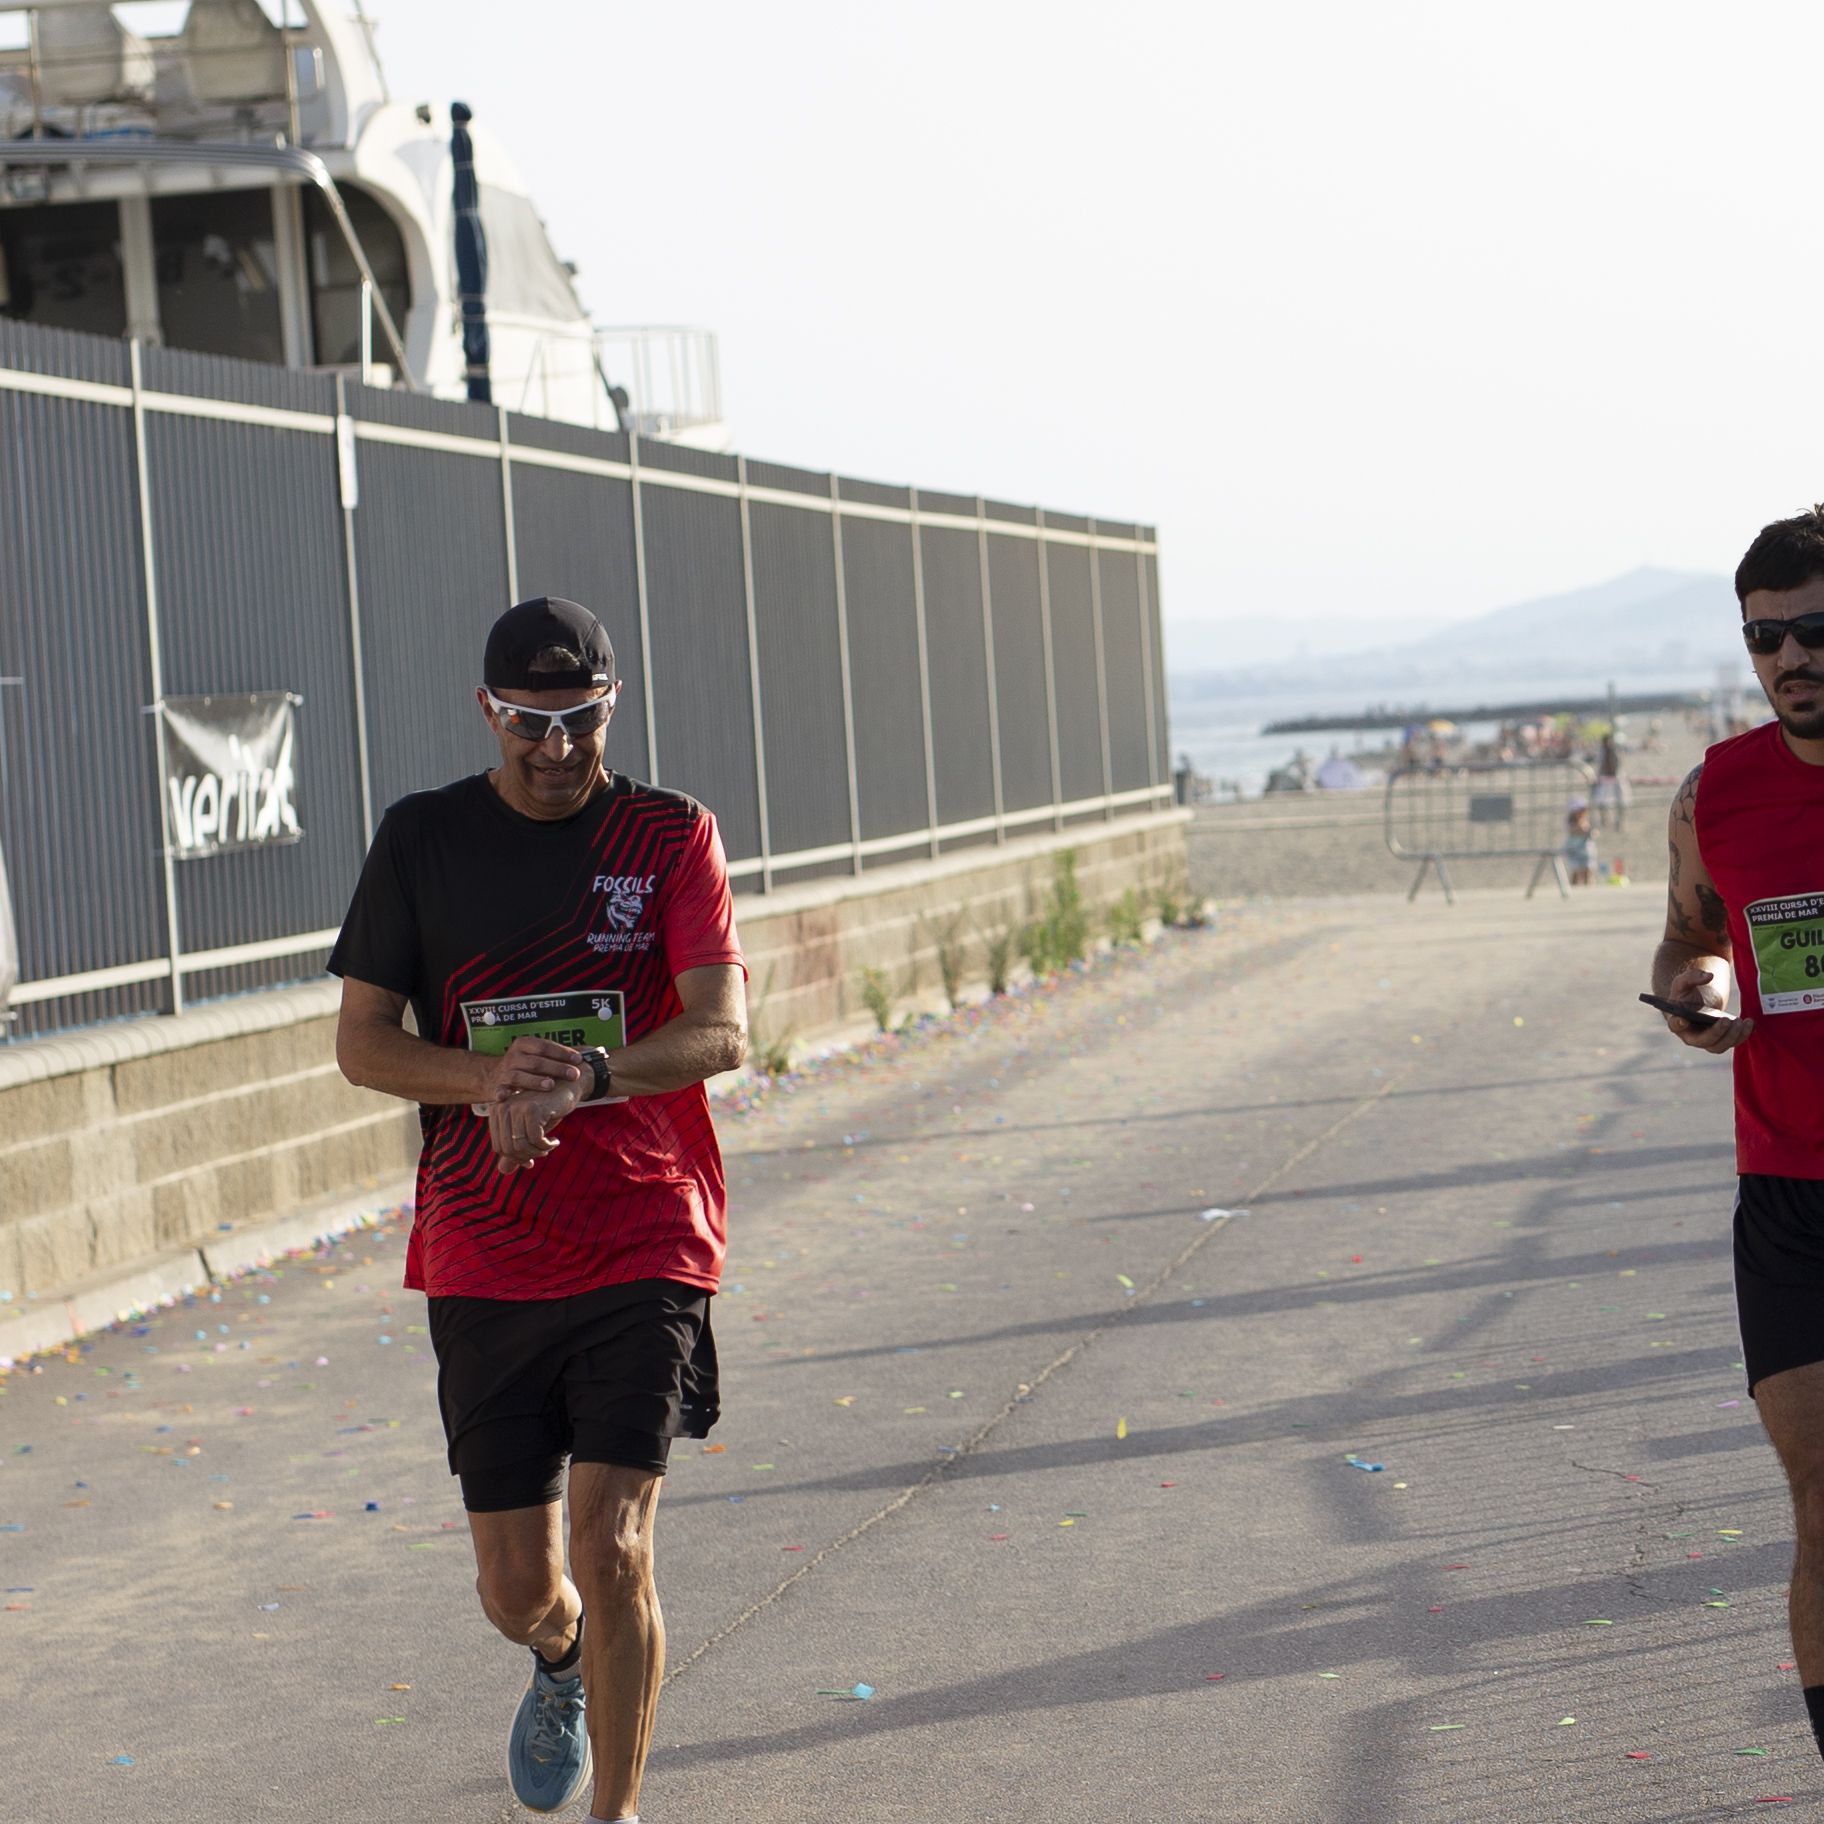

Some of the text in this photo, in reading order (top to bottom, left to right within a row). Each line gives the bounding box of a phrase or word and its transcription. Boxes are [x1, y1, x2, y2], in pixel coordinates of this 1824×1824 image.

[593, 874, 656, 894] FOSSILS
[1750, 903, 1778, 914] XXVIII
[1780, 899, 1808, 910] CURSA
[1785, 911, 1796, 919] DE
[1798, 908, 1818, 917] MAR
[587, 931, 655, 944] RUNNING TEAM
[498, 1003, 528, 1013] CURSA
[591, 998, 611, 1010] 5K
[517, 1011, 537, 1020] MAR
